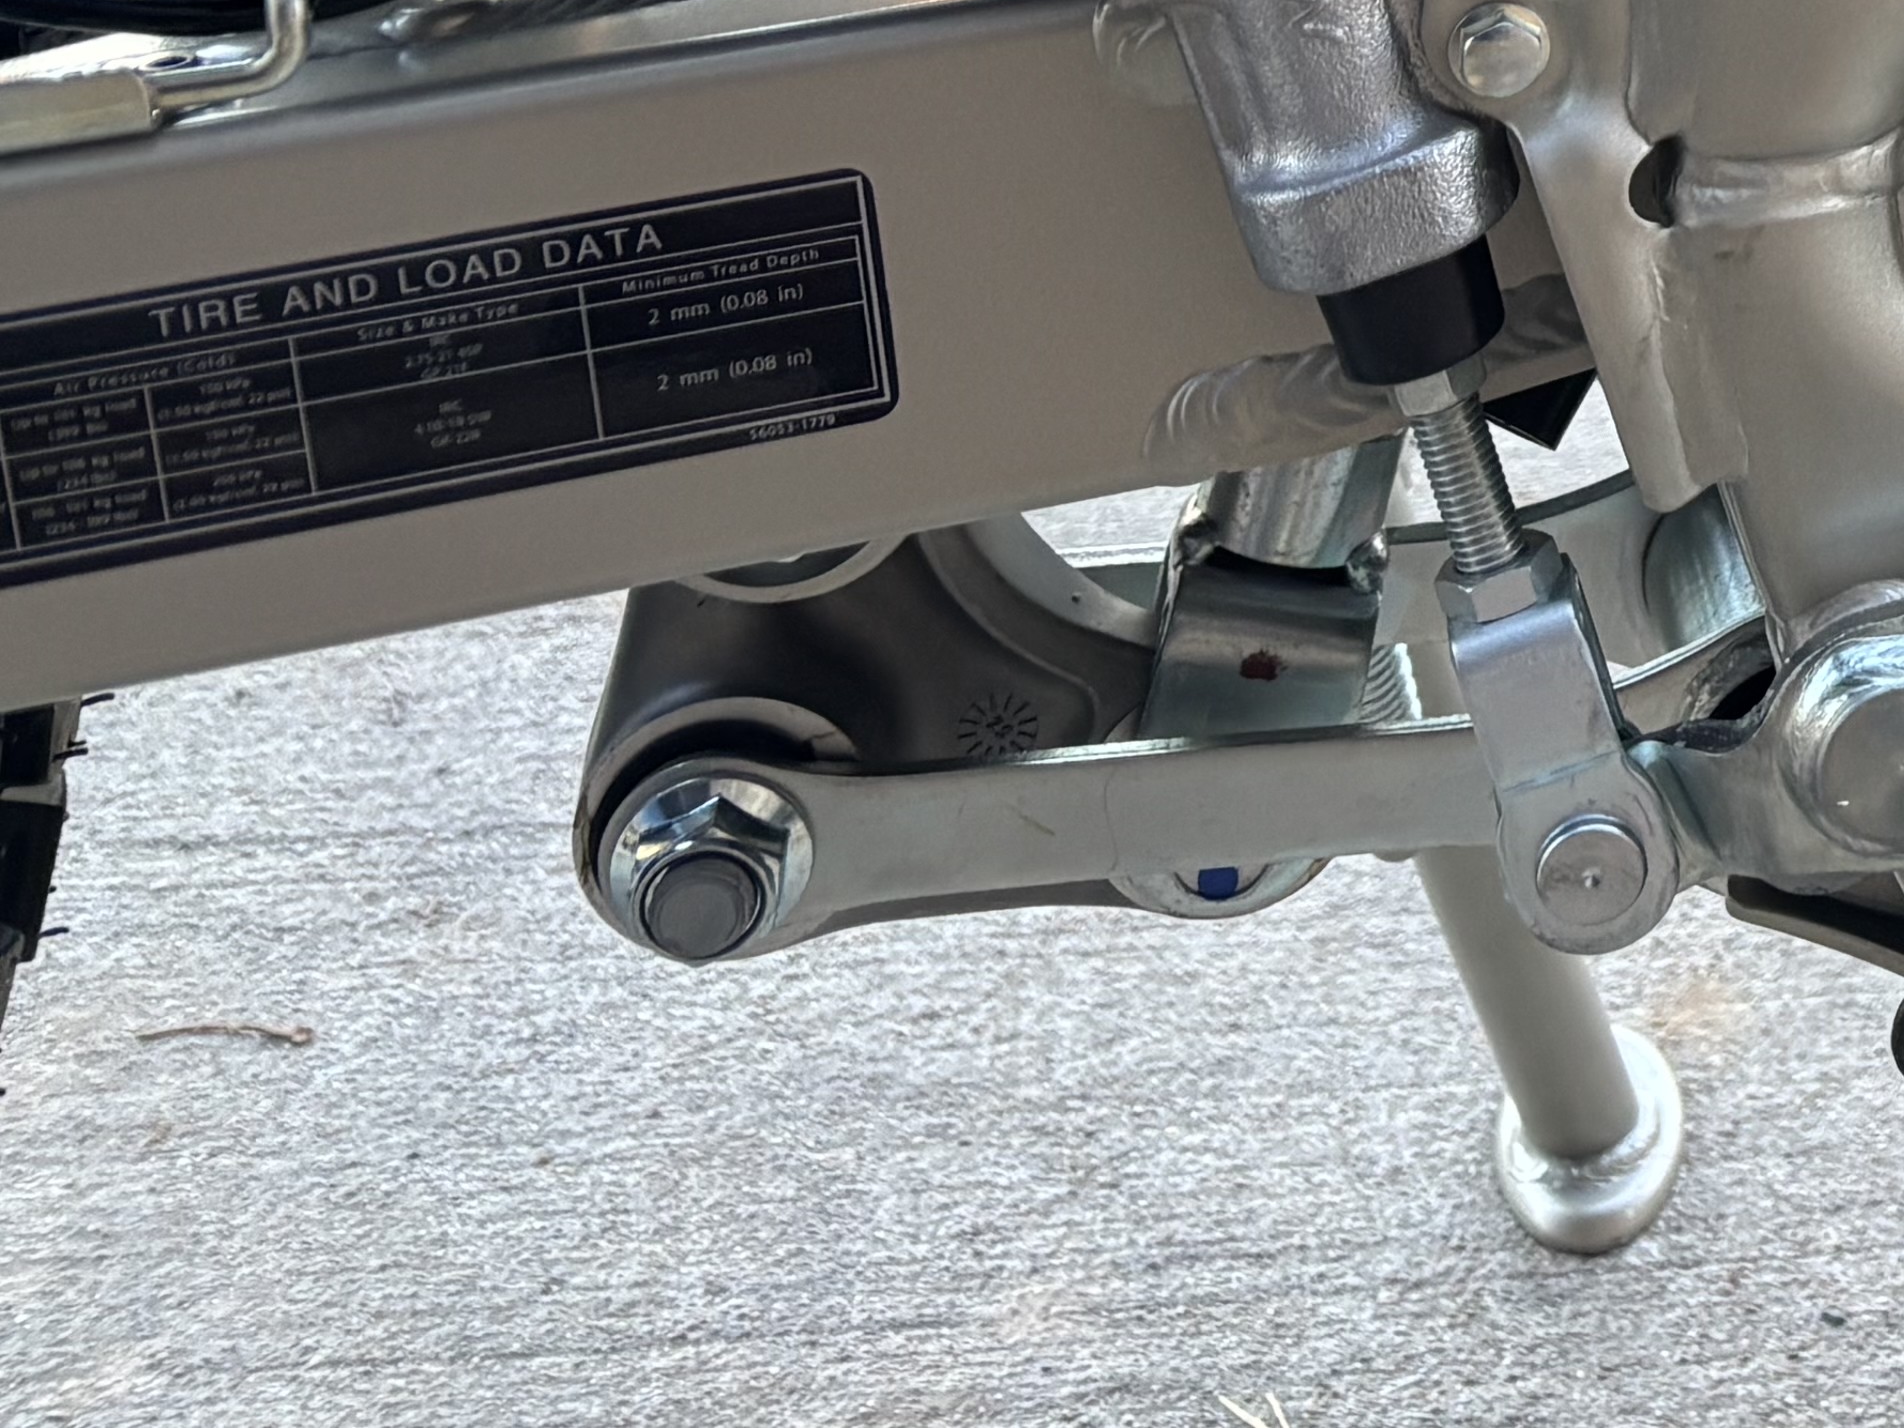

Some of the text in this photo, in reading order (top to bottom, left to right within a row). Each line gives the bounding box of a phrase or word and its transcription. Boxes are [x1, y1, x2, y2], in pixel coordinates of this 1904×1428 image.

[149, 224, 663, 338] TIRE AND LOAD DATA
[621, 248, 820, 294] Minimum Tread Depth
[647, 308, 661, 326] 2
[670, 302, 711, 321] mm
[777, 283, 804, 303] in)
[655, 374, 670, 392] 2
[679, 365, 720, 387] mm
[786, 347, 814, 367] in)
